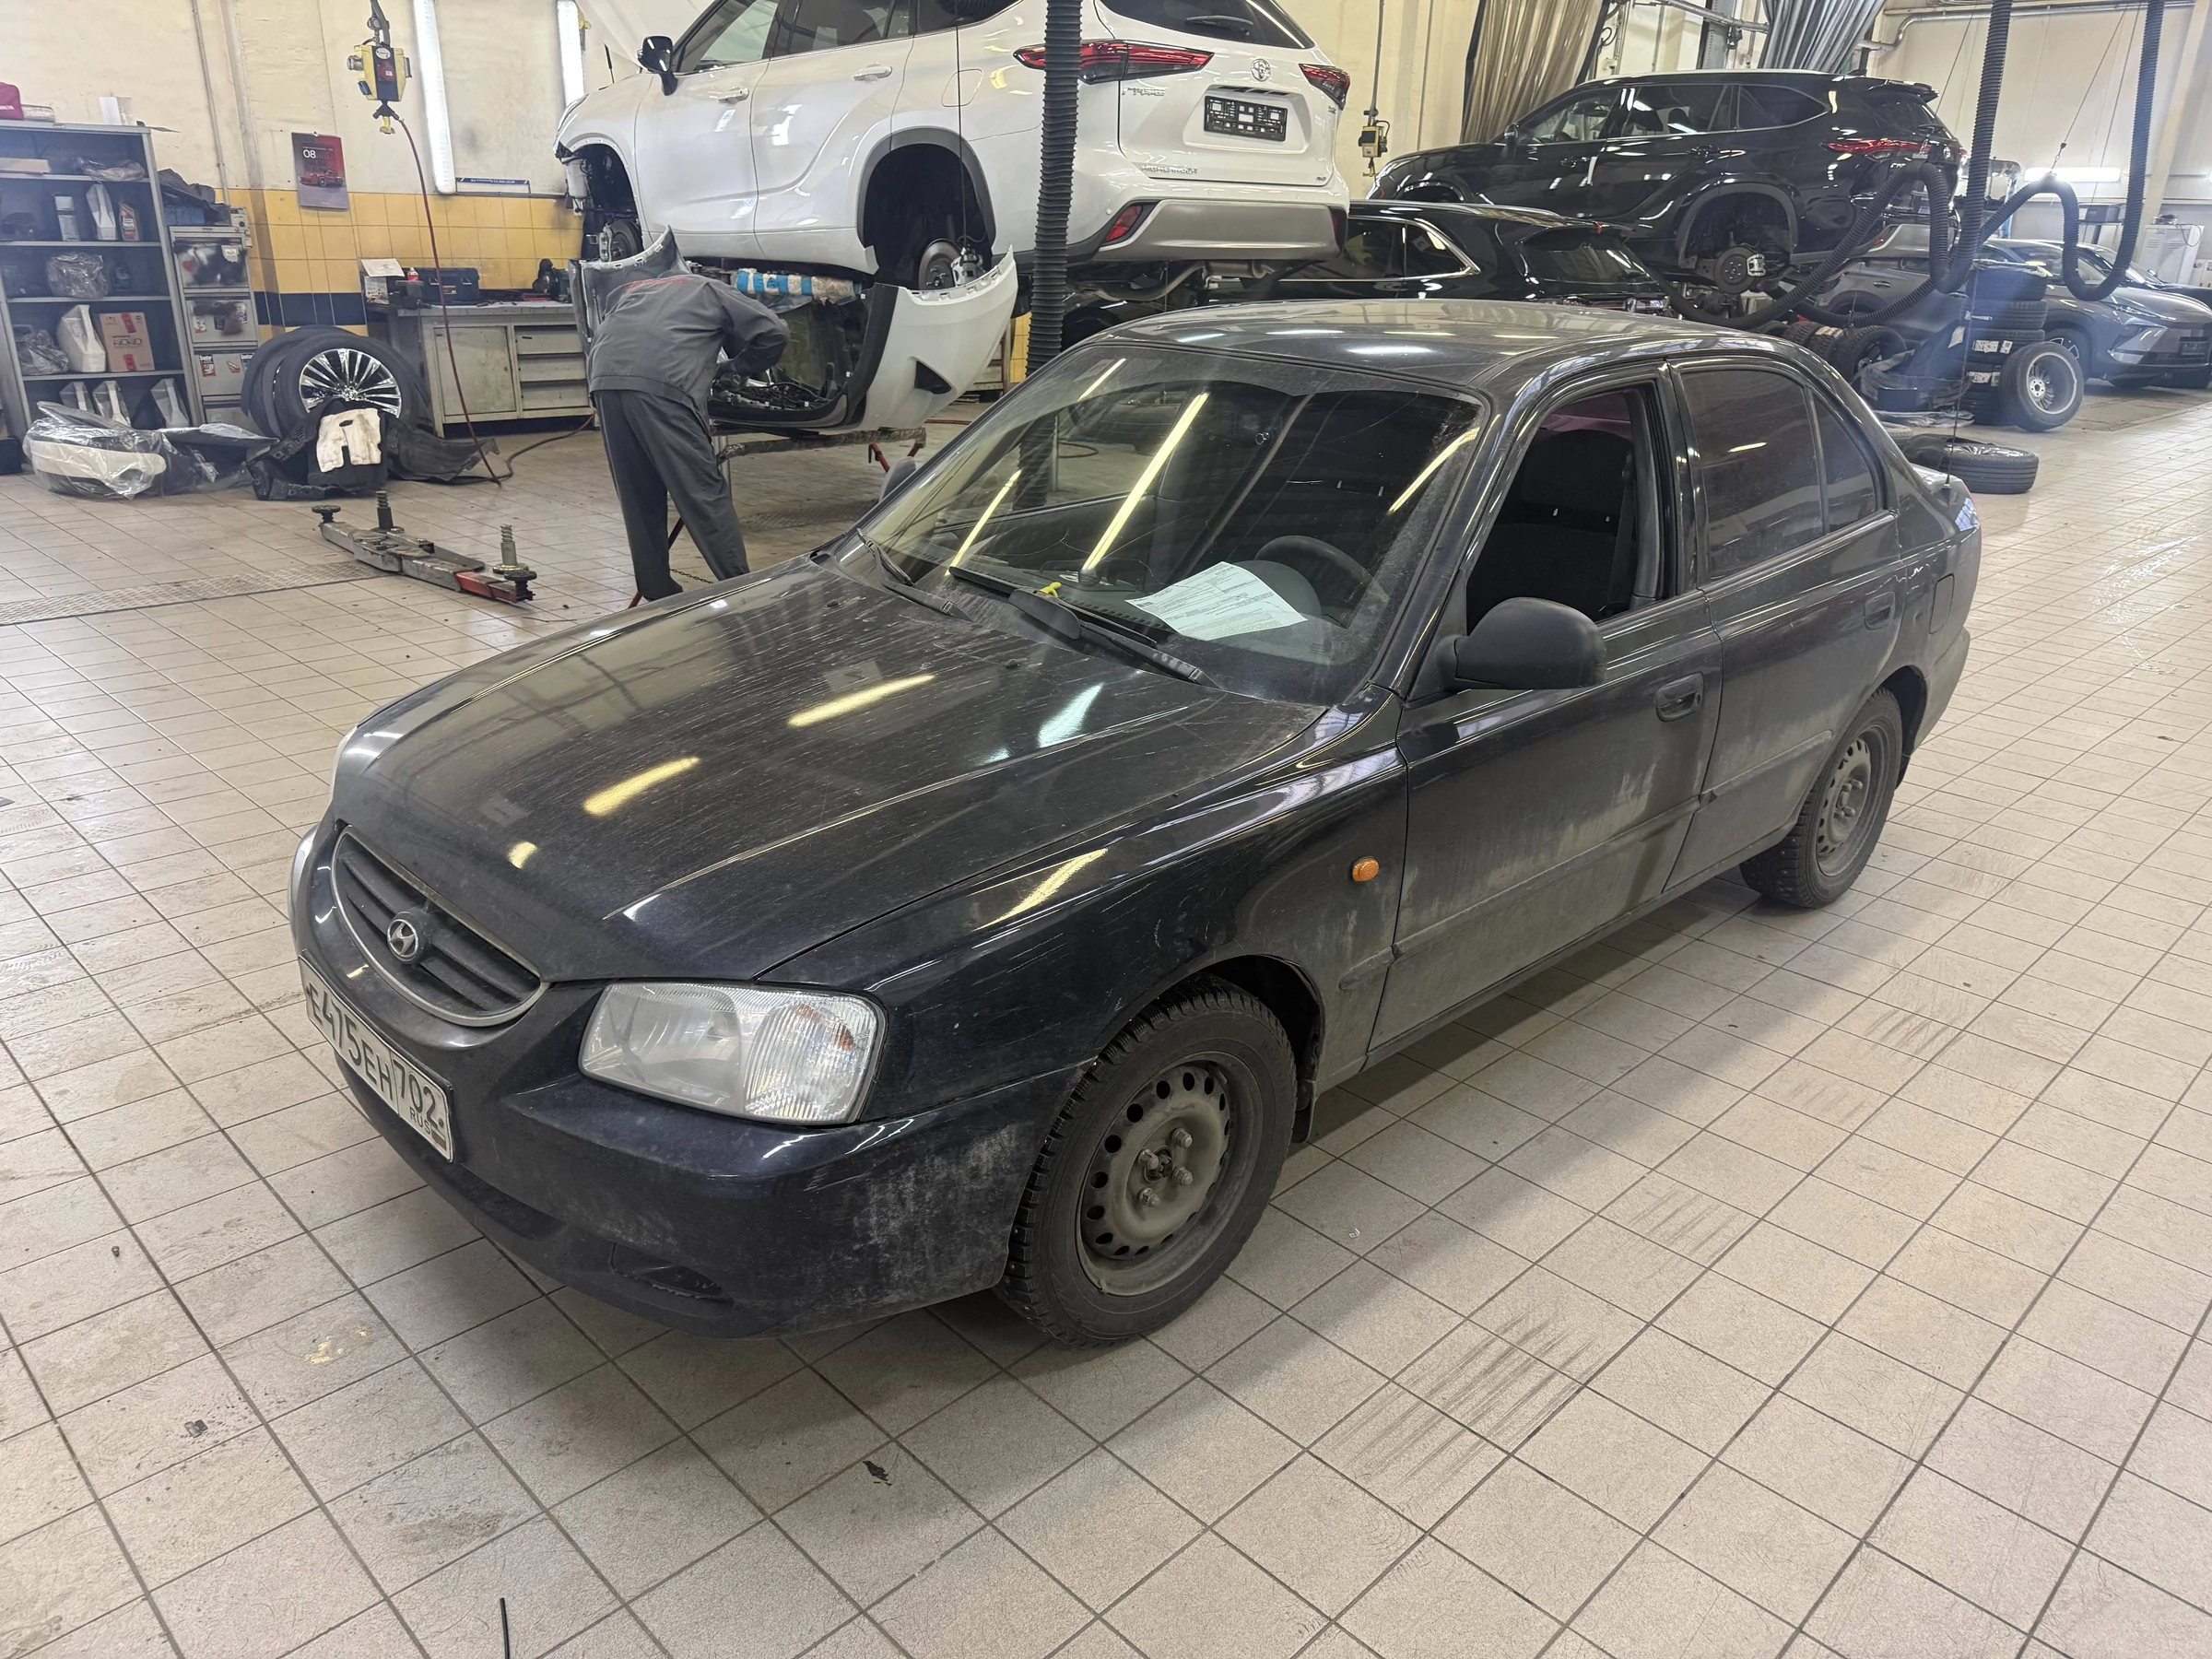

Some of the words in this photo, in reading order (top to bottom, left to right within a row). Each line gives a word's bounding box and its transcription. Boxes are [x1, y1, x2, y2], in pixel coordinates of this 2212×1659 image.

[302, 148, 316, 159] 08
[393, 1058, 439, 1130] 702
[409, 1106, 432, 1135] RUS
